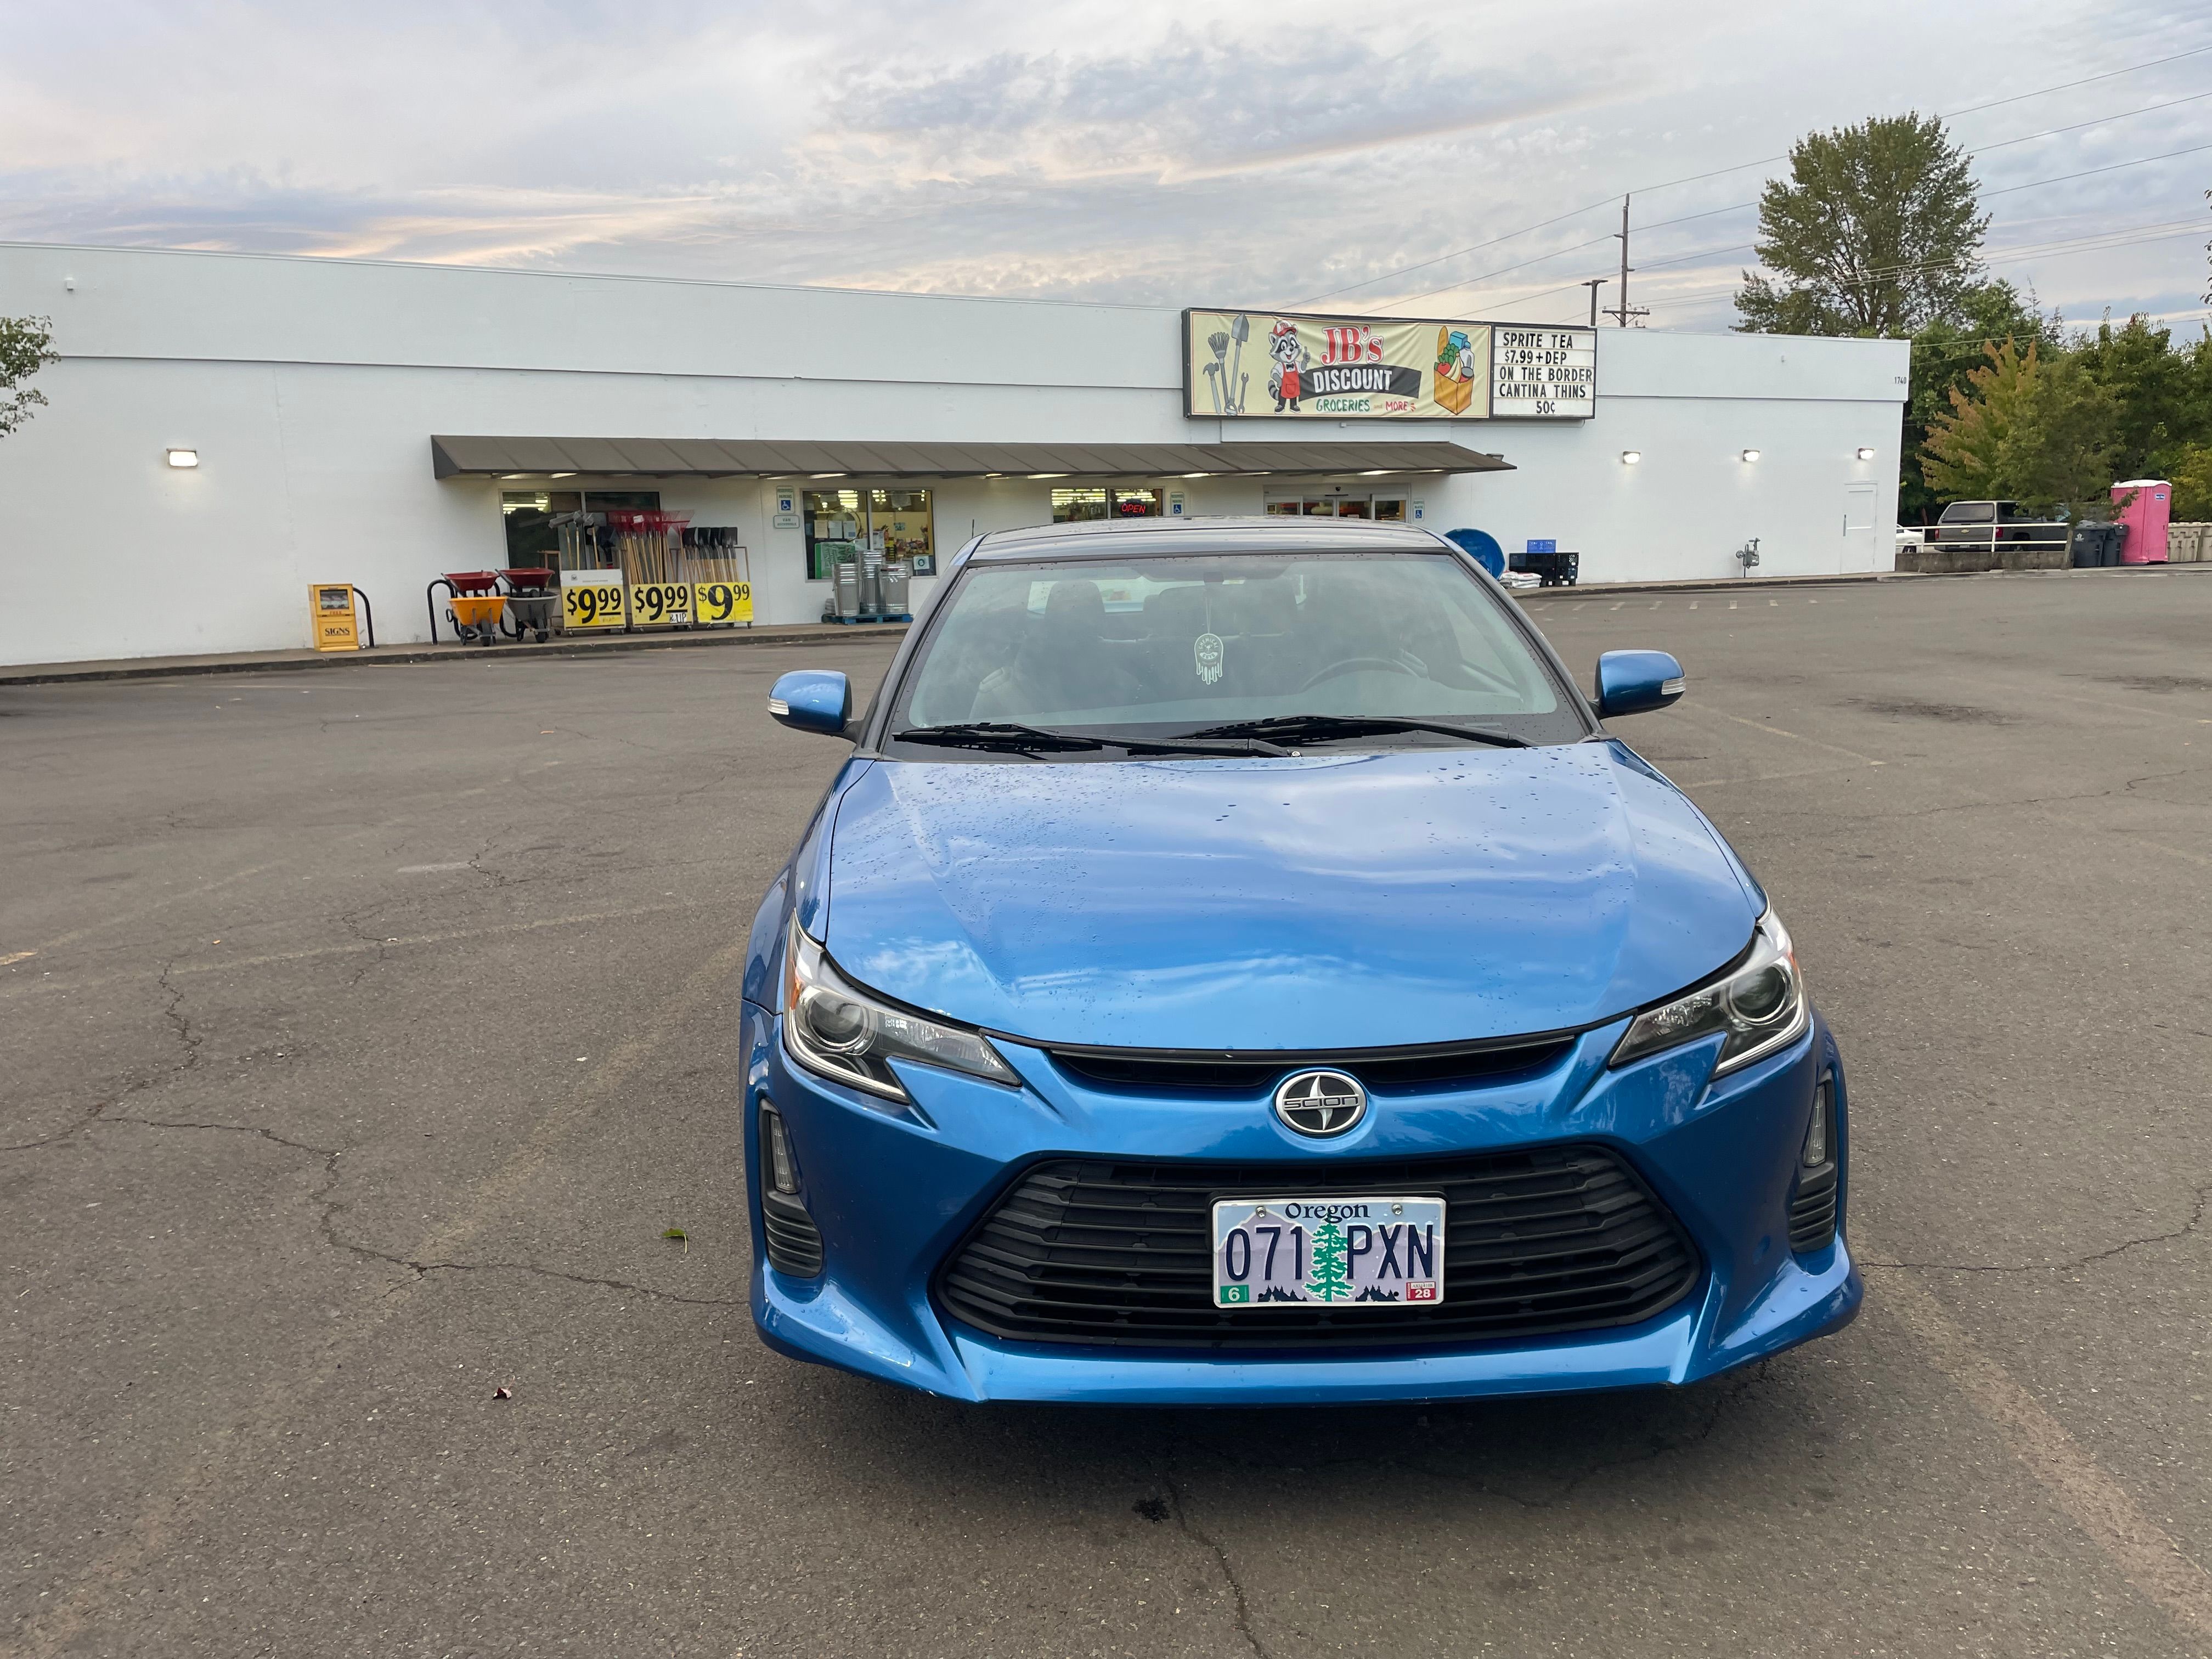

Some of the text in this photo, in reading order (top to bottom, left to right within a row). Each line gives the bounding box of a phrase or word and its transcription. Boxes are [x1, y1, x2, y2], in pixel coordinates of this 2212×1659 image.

[1321, 325, 1384, 366] JB's
[1503, 332, 1573, 348] SPRITE TEA
[1312, 368, 1392, 393] DISCOUNT
[1500, 366, 1593, 382] ON THE BORDER
[1499, 383, 1585, 398] CANTINA THINS
[1317, 399, 1370, 412] GROCERIES
[1386, 401, 1408, 411] MORE
[1536, 400, 1555, 414] 50¢
[1121, 503, 1146, 514] OPEN
[325, 627, 350, 636] SIGNS
[1284, 1097, 1358, 1109] SCION
[1285, 1202, 1371, 1224] Oregon
[1226, 1224, 1433, 1281] 071 PXN
[1228, 1287, 1240, 1301] 6
[1415, 1289, 1431, 1298] 28
